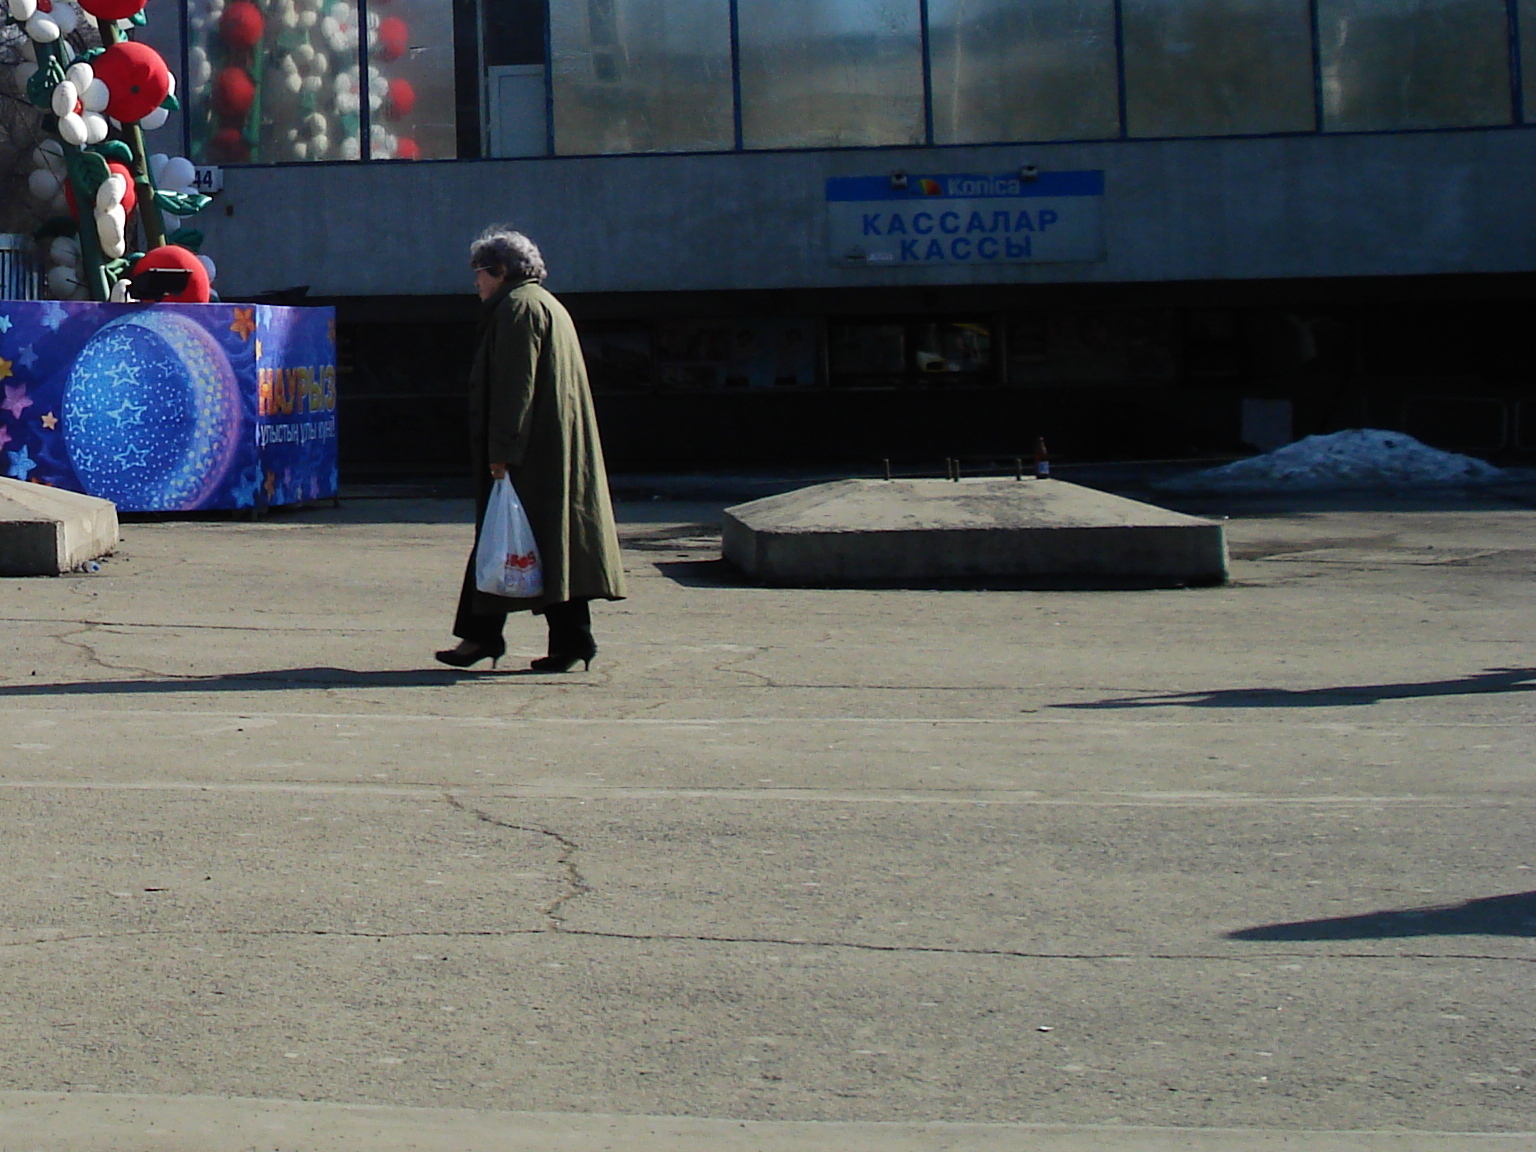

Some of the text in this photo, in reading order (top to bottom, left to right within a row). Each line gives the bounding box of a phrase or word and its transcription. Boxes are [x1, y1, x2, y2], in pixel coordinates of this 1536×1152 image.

[947, 176, 1021, 197] Konica
[862, 209, 1059, 236] КАССАЛАР
[900, 235, 1032, 262] КАССЫ
[259, 365, 337, 416] НАУРЫЗ
